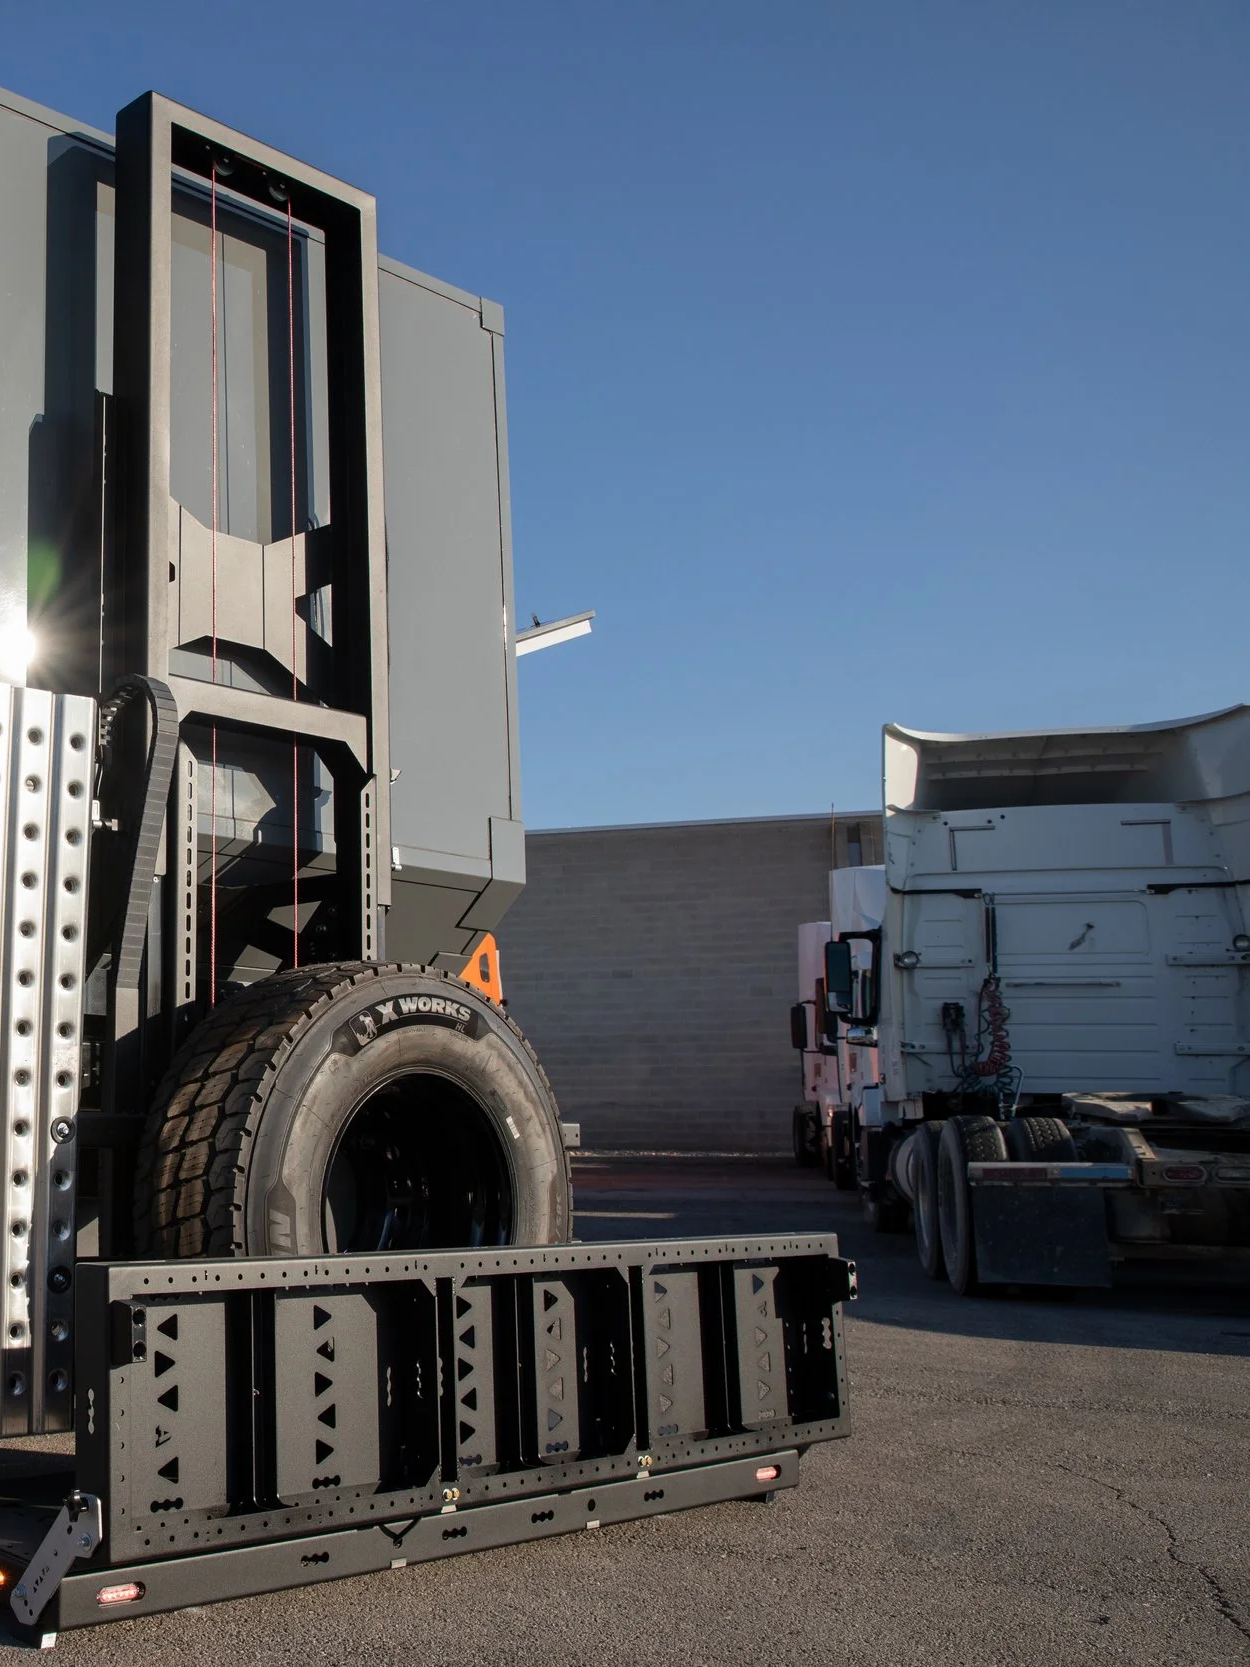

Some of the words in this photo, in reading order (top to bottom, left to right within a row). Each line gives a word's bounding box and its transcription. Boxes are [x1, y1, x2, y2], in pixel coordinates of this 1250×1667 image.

[375, 1000, 399, 1024] X
[398, 996, 471, 1022] WORKS
[455, 1022, 466, 1034] HL
